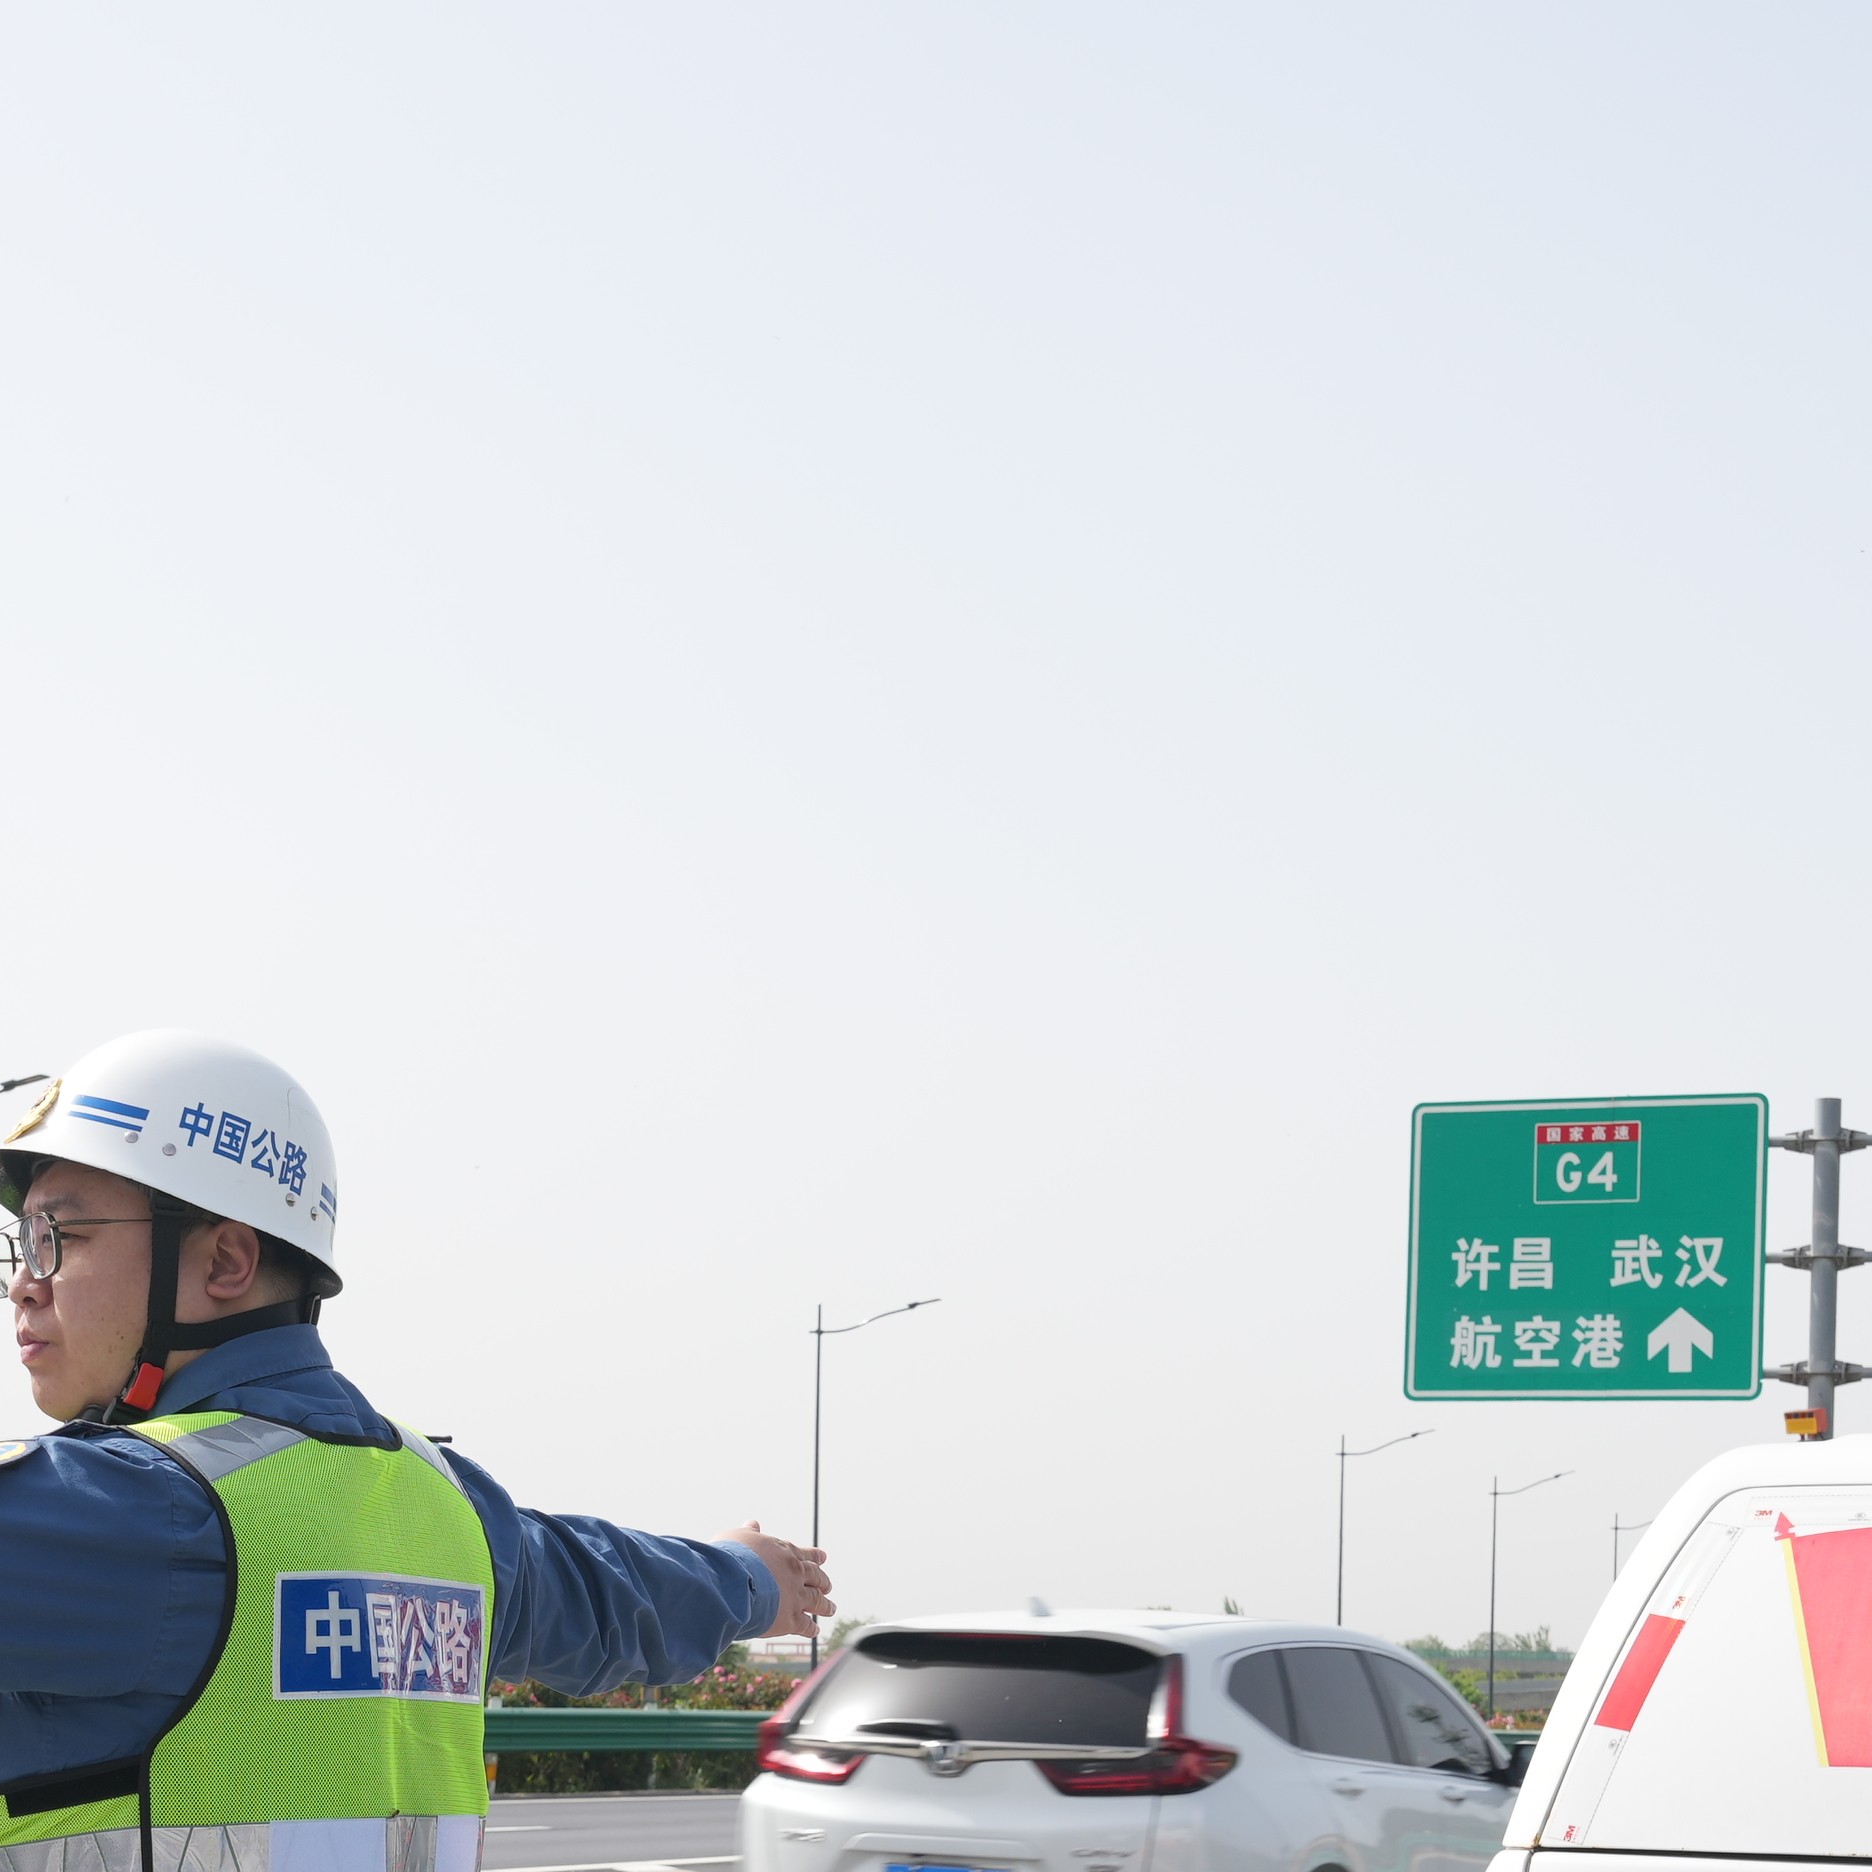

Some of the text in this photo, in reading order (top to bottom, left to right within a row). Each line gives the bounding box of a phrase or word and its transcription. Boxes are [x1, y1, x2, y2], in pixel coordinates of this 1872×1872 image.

[179, 1102, 308, 1197] 中国公路
[1546, 1125, 1630, 1142] 国家高速
[1556, 1151, 1618, 1193] G4
[1451, 1234, 1728, 1291] 许昌 武汉
[1450, 1314, 1624, 1370] 航空港
[1755, 1509, 1773, 1517] 3M
[305, 1591, 471, 1684] 中国公路
